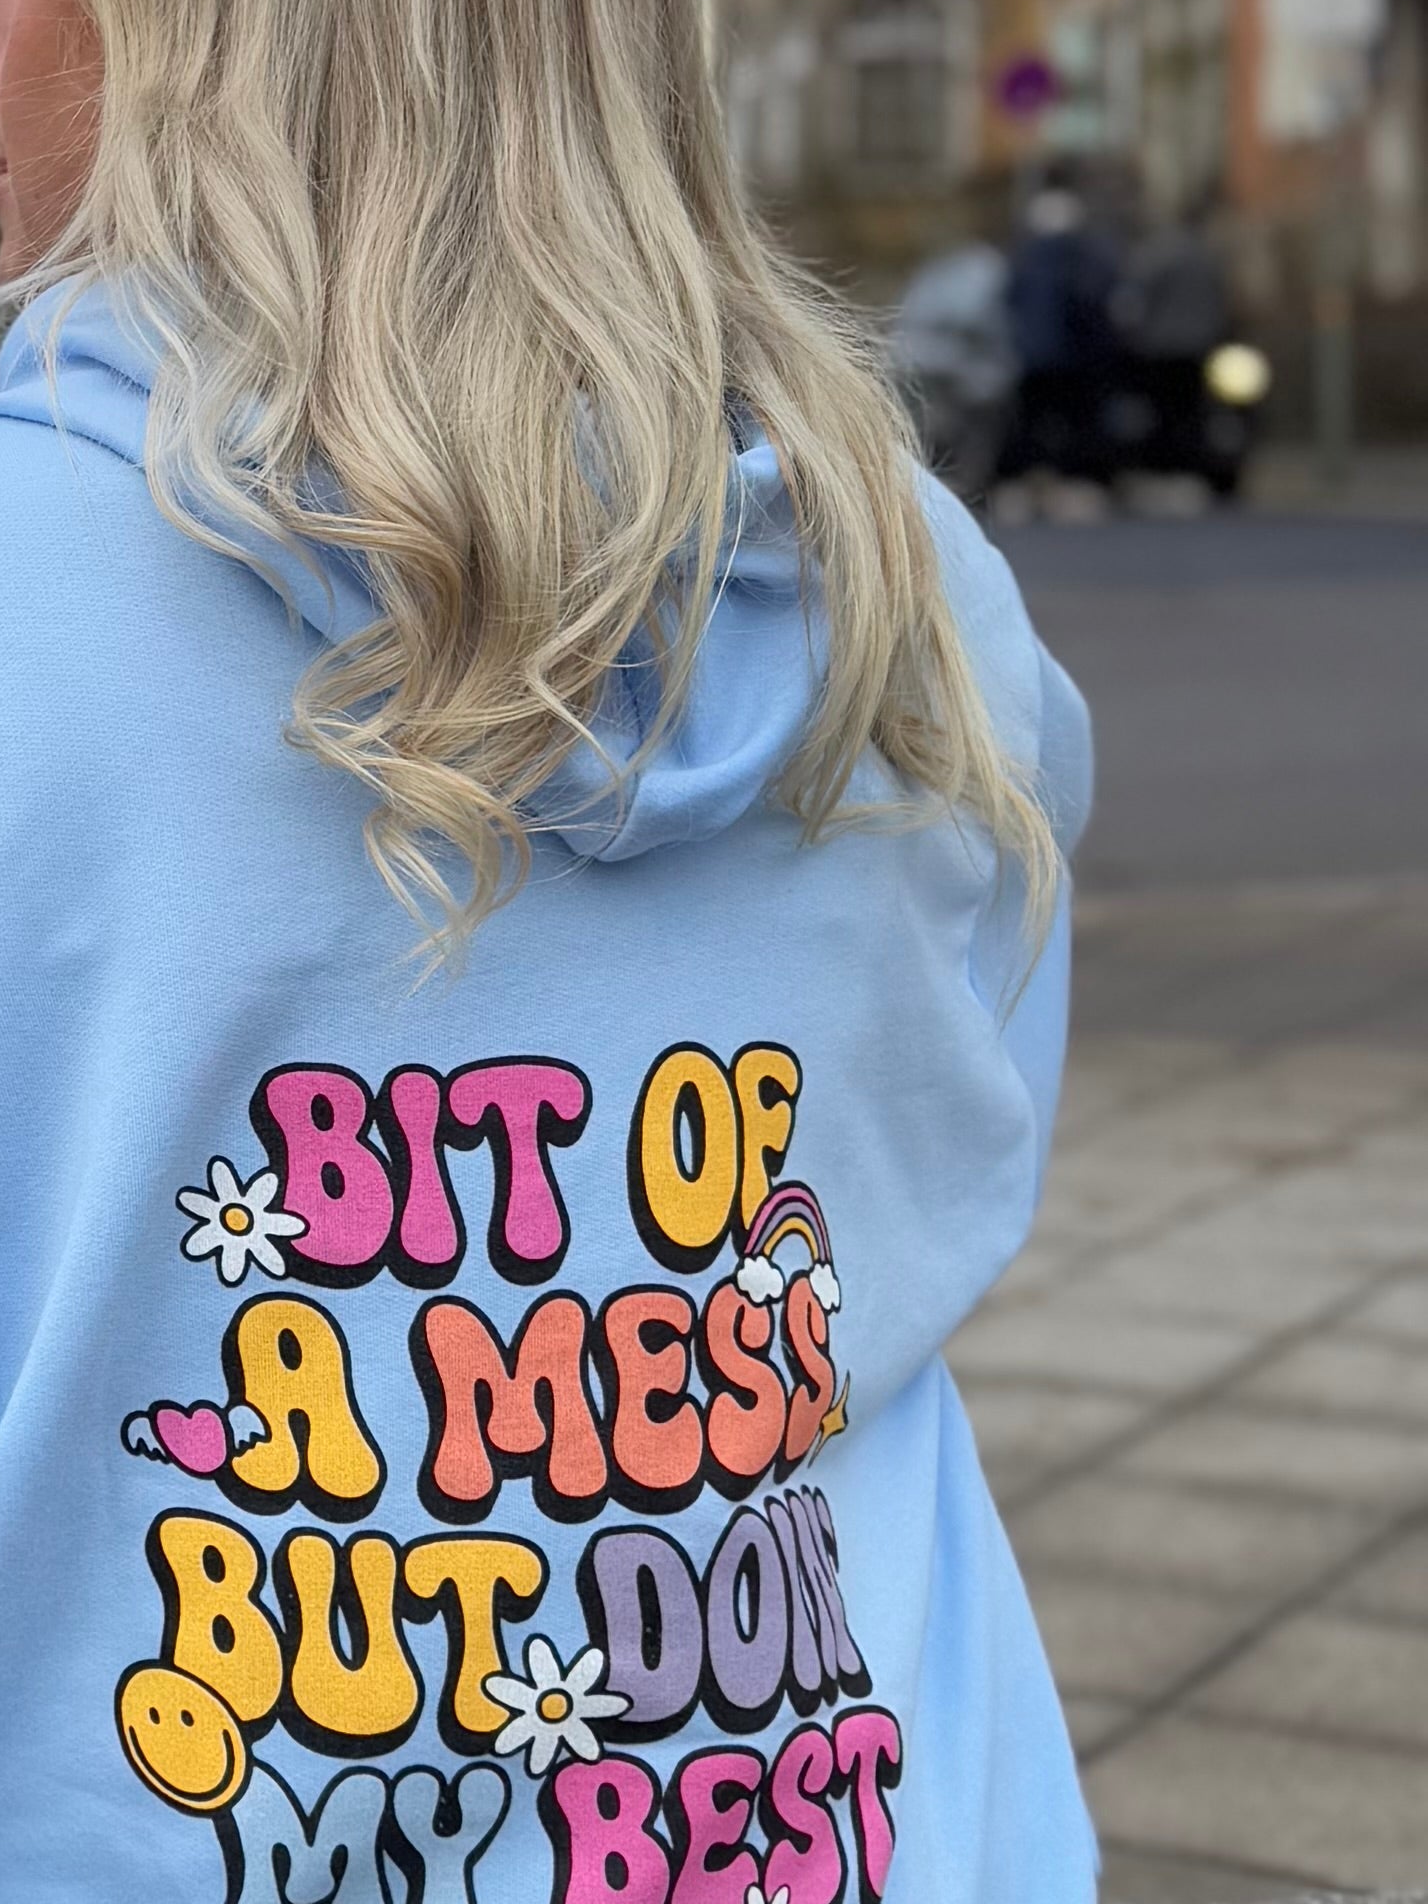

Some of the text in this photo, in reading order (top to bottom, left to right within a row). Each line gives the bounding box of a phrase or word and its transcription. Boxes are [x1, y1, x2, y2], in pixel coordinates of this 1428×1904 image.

[250, 1040, 804, 1290] BIT OF
[220, 1268, 836, 1523] A MESS
[145, 1506, 549, 1760] BUT
